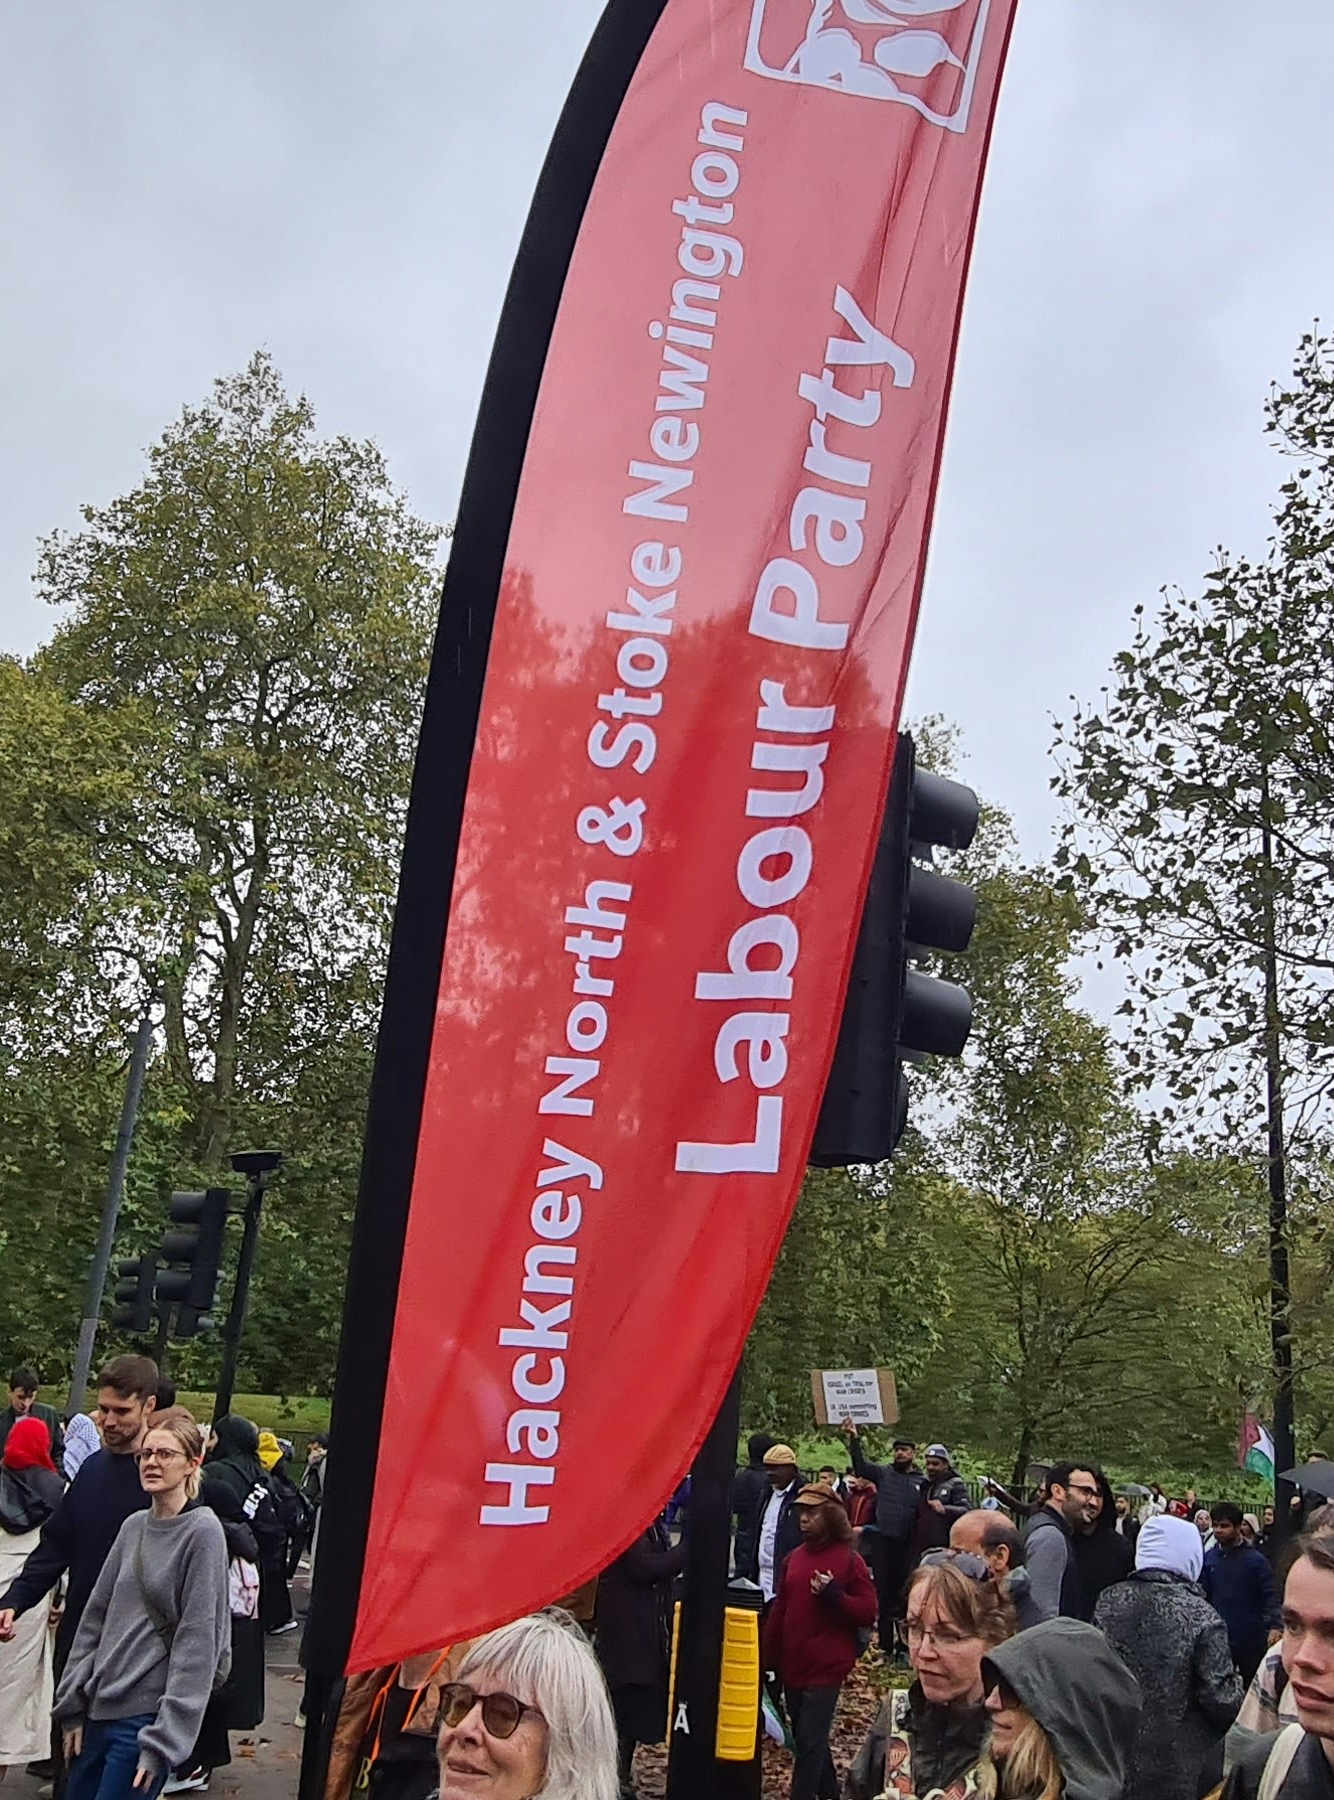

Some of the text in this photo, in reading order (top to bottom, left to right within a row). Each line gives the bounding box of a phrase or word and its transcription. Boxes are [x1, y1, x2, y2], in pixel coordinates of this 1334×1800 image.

[480, 100, 749, 1526] Hackney North & Stoke Newington
[674, 284, 916, 1175] Labour Party
